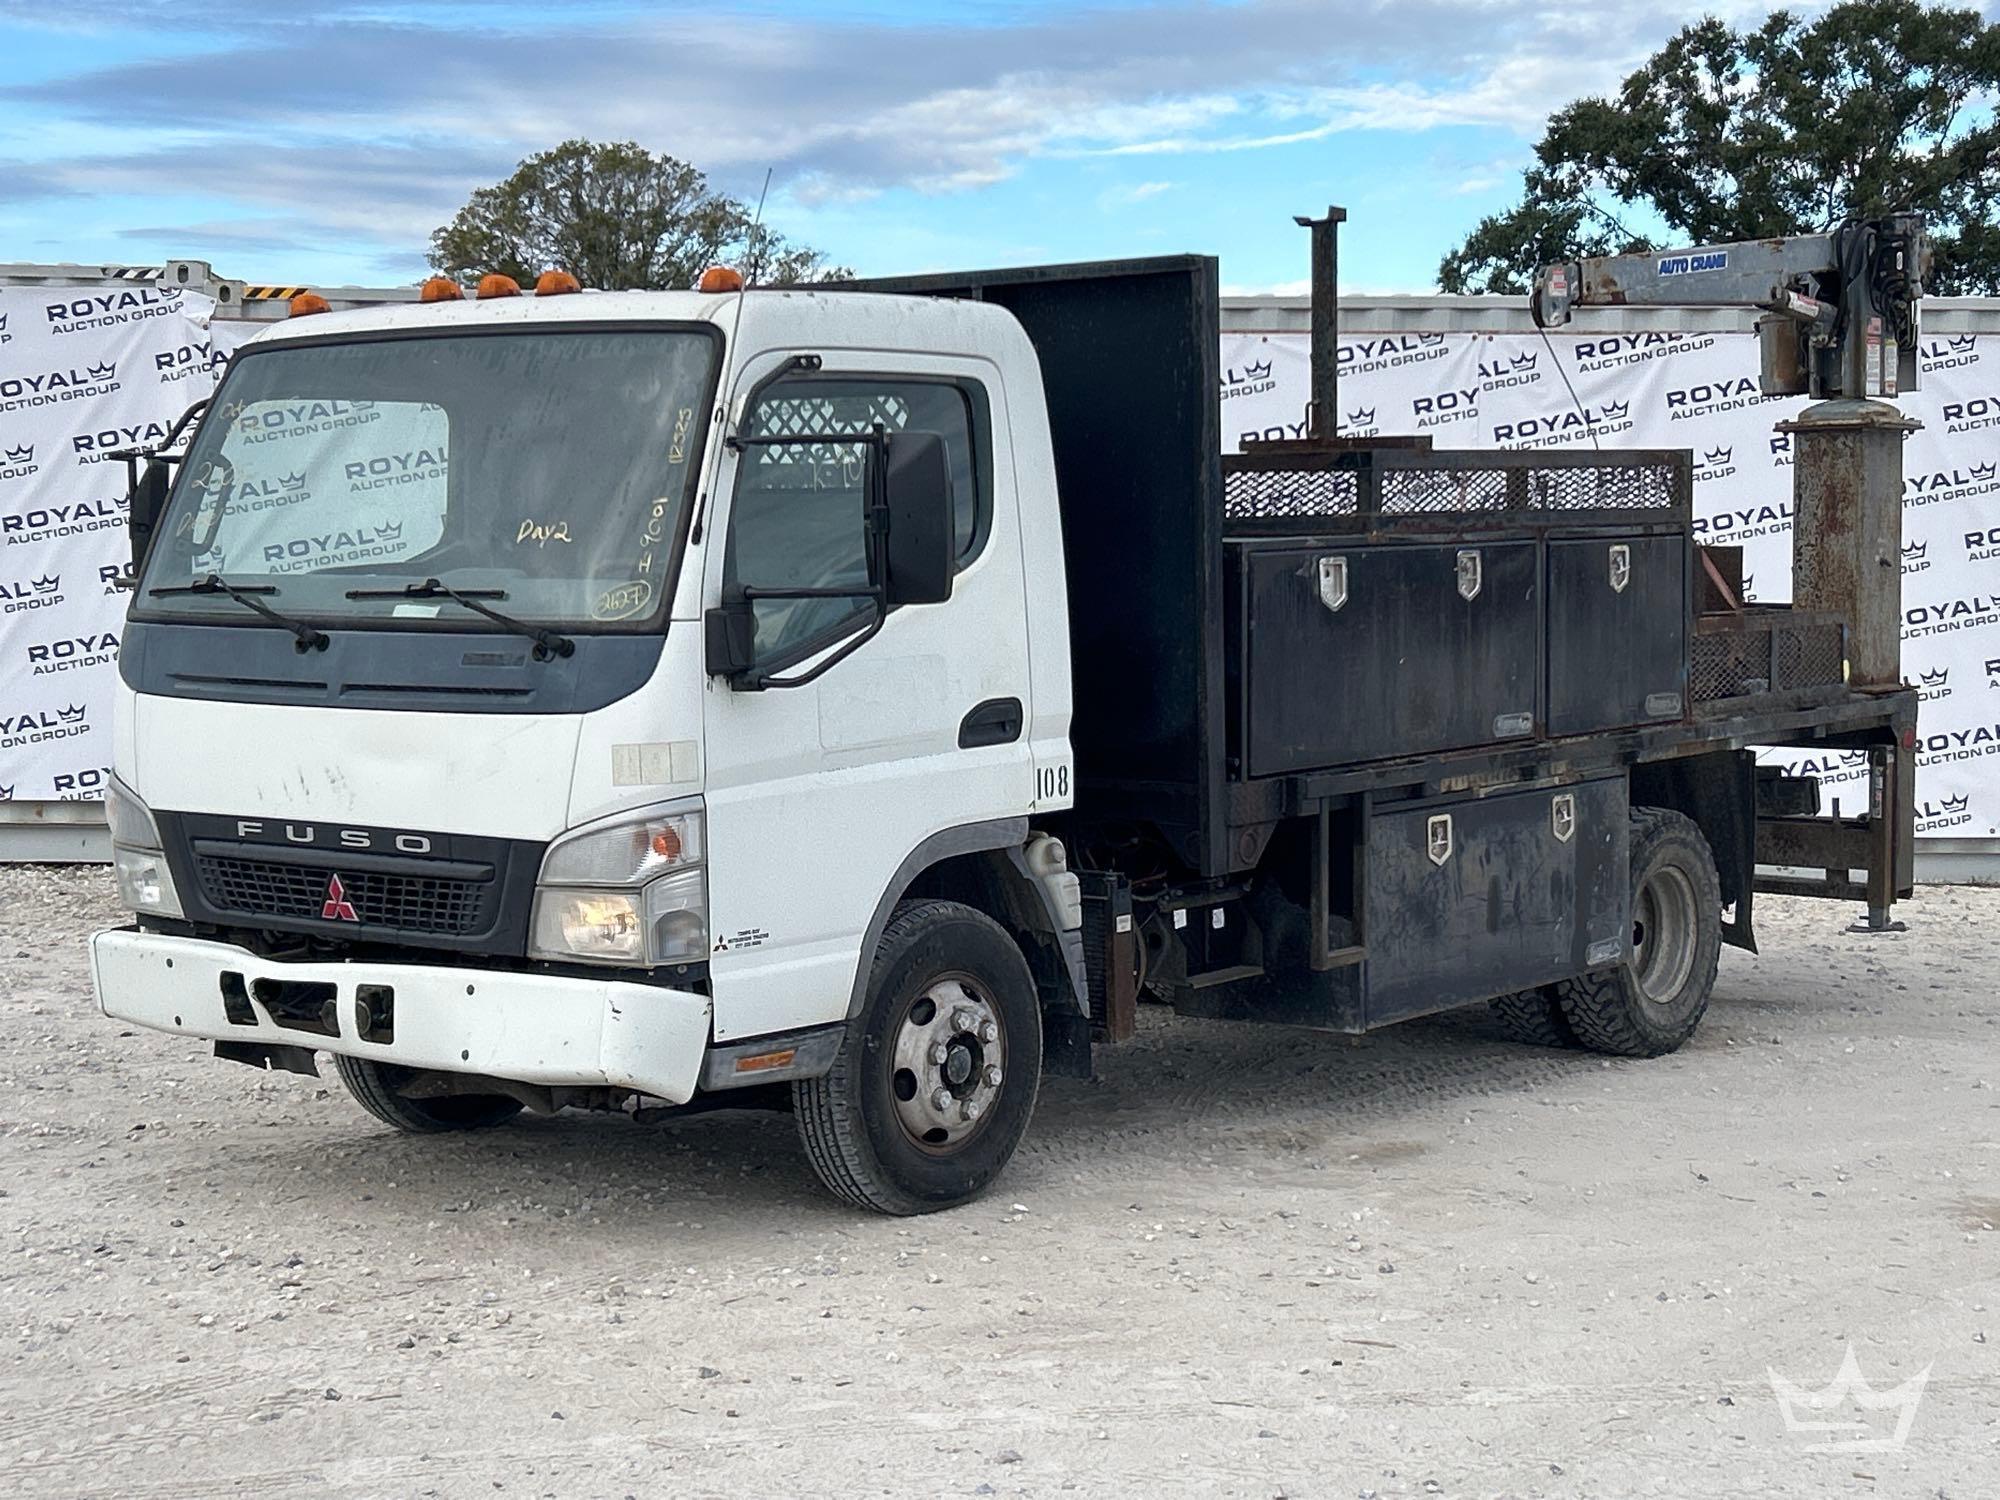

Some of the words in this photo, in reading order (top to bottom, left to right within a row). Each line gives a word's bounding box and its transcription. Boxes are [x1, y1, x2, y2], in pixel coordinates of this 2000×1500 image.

[1659, 258, 1689, 275] AUTO
[46, 288, 159, 322] ROYAL
[52, 313, 128, 335] AUCTION
[131, 301, 184, 321] GROUP
[155, 341, 239, 370] ROYA
[1337, 336, 1418, 364] OYAL
[1575, 332, 1683, 361] ROYAL
[1579, 350, 1653, 374] AUCTION
[1656, 338, 1715, 357] GROUP
[1337, 359, 1388, 377] CTION
[1391, 347, 1449, 366] GROUP
[1921, 354, 1980, 373] GROUP
[0, 369, 89, 397] OYAL
[1220, 381, 1276, 400] GROUP
[1483, 373, 1541, 391] GROUP
[1666, 377, 1758, 408] ROYA
[0, 394, 57, 412] CTION
[61, 383, 121, 401] GROUP
[1413, 387, 1480, 415] ROY
[1671, 398, 1745, 421] AUCTION
[1748, 394, 1796, 406] GRO
[1943, 397, 2000, 422] ROY
[240, 400, 349, 433] ROYAL
[243, 424, 318, 446] AUCTION
[322, 411, 381, 431] GROUP
[1417, 408, 1479, 429] AUCTIO
[1493, 409, 1602, 442] ROYAL
[1947, 415, 2000, 434] AUCTI
[1241, 421, 1305, 443] ROY
[1337, 427, 1379, 439] OUP
[1500, 432, 1571, 450] AUCTION
[1574, 421, 1633, 440] GROUP
[0, 465, 38, 479] OUP
[345, 447, 448, 480] ROYAL
[1692, 467, 1736, 482] ROUP
[350, 470, 425, 493] AUCTION
[1907, 470, 1969, 492] YAL
[252, 492, 311, 512] GROUP
[1902, 494, 1940, 508] TION
[1943, 482, 2000, 501] GROUP
[2, 500, 114, 533] ROYAL
[1691, 503, 1794, 534] ROYAL
[7, 524, 83, 545] AUCTION
[87, 517, 129, 531] GRO
[264, 528, 375, 562] ROYAL
[269, 553, 345, 574] AUCTION
[348, 541, 408, 560] GROUP
[1900, 561, 1931, 574] OUP
[4, 595, 65, 613] GROUP
[1900, 597, 1990, 625] OYAL
[1900, 621, 1960, 640] UCTION
[1964, 614, 2000, 628] GRO
[28, 633, 120, 662] ROYA
[33, 654, 109, 675] AUCTION
[1917, 688, 1952, 701] OUP
[0, 712, 58, 735] YAL
[30, 724, 90, 743] GROUP
[1781, 756, 1840, 777] YAL
[1914, 747, 1982, 767] UCTION
[60, 788, 105, 800] AUCT
[1037, 765, 1068, 800] 108
[1915, 814, 1972, 832] GROUP
[237, 821, 431, 853] FUSO
